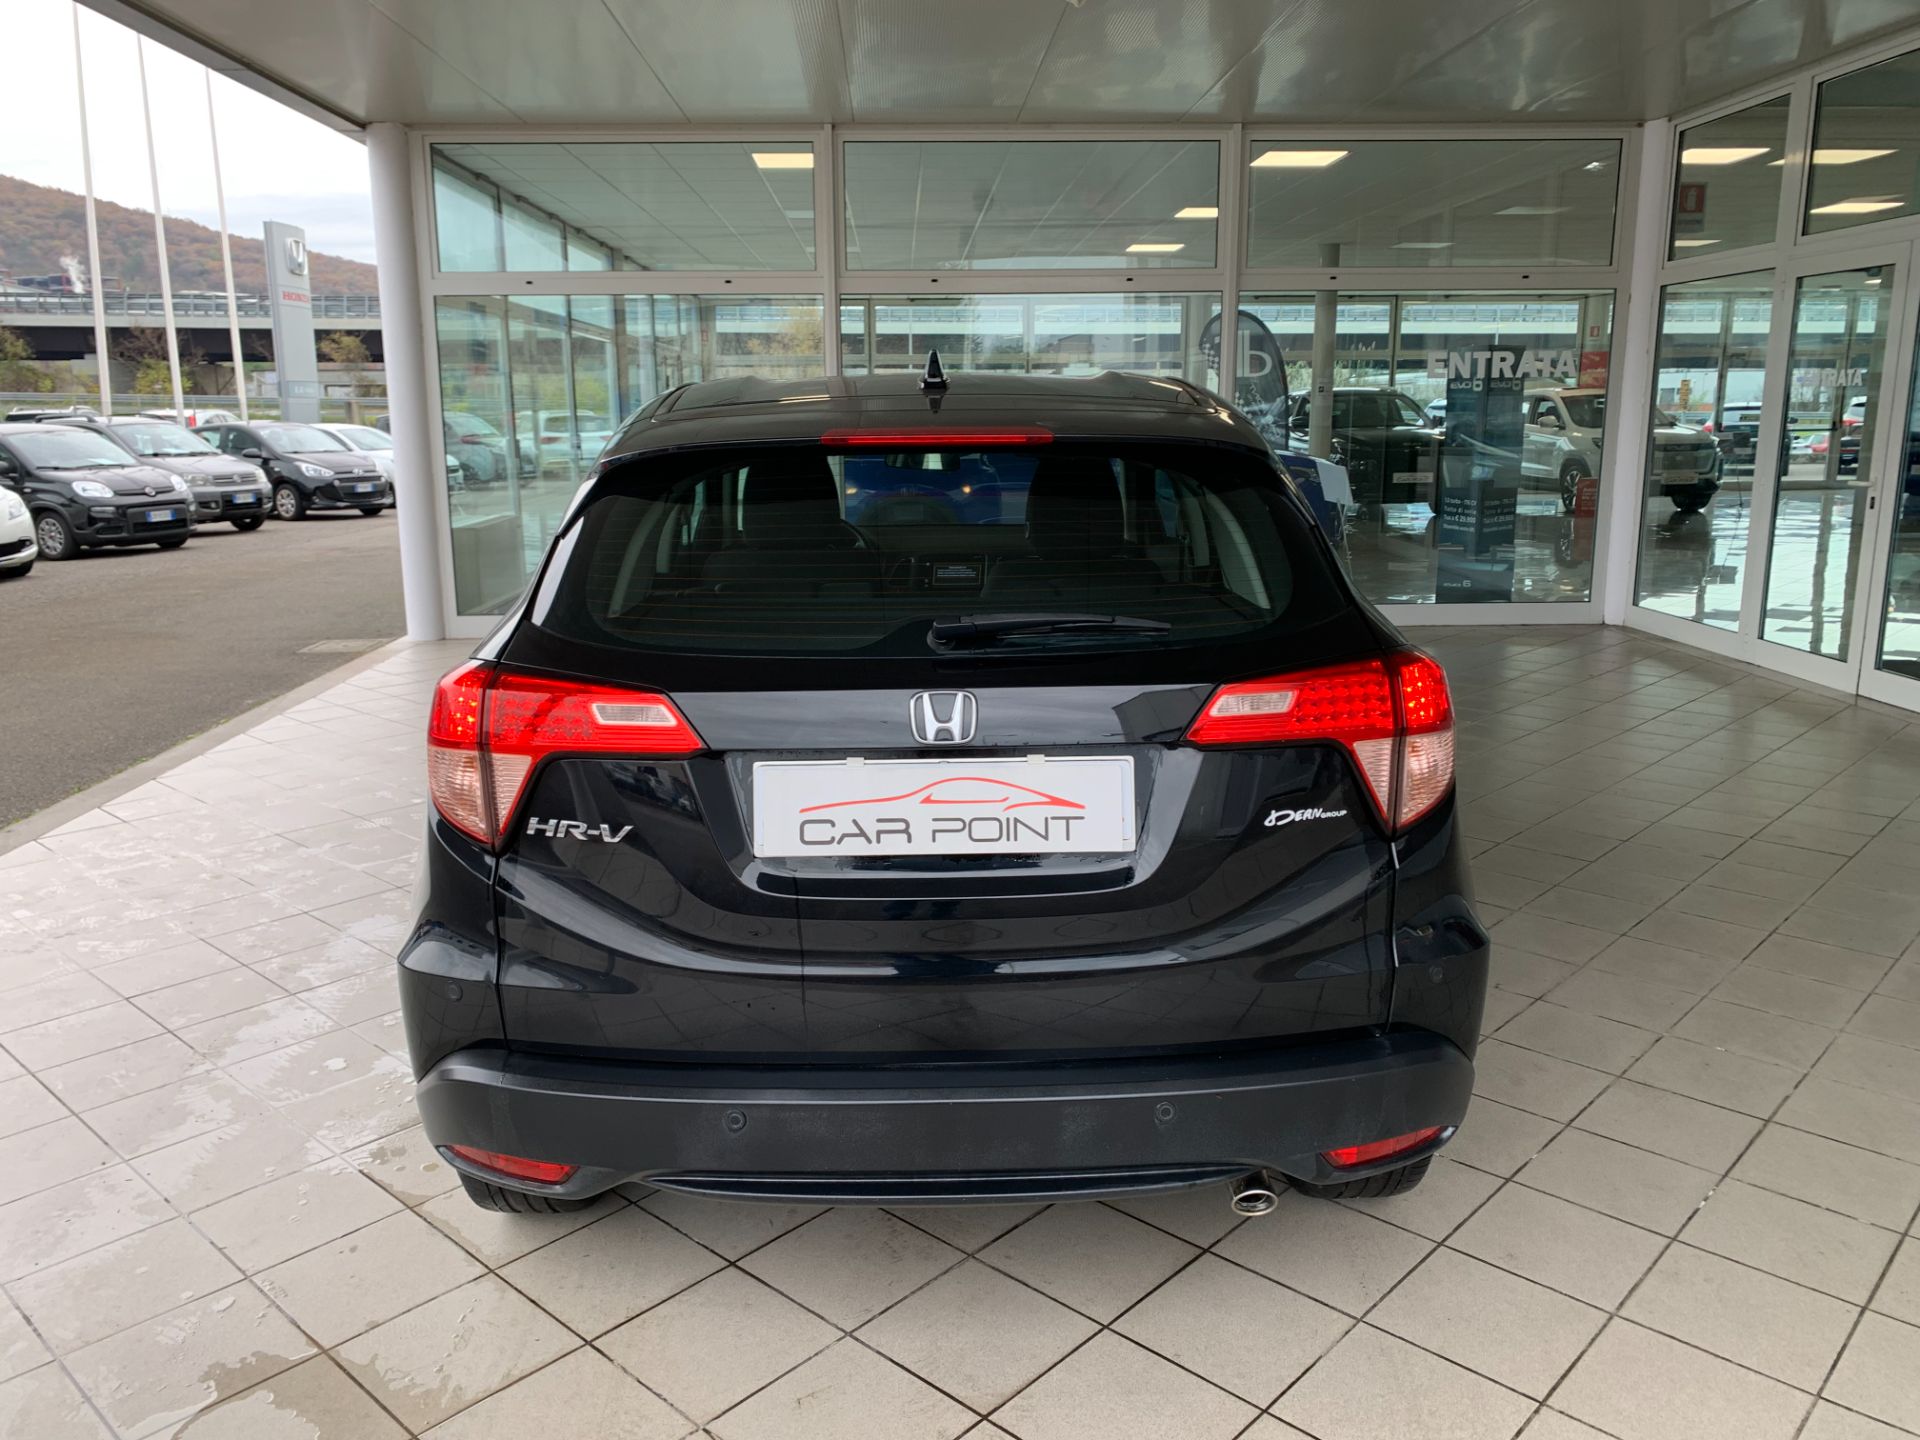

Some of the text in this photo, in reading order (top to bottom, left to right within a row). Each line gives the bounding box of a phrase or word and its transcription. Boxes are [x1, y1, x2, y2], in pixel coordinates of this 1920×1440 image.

[1427, 350, 1577, 379] ENTRATA
[526, 817, 634, 843] HR-V
[800, 815, 1086, 845] CAR POINT
